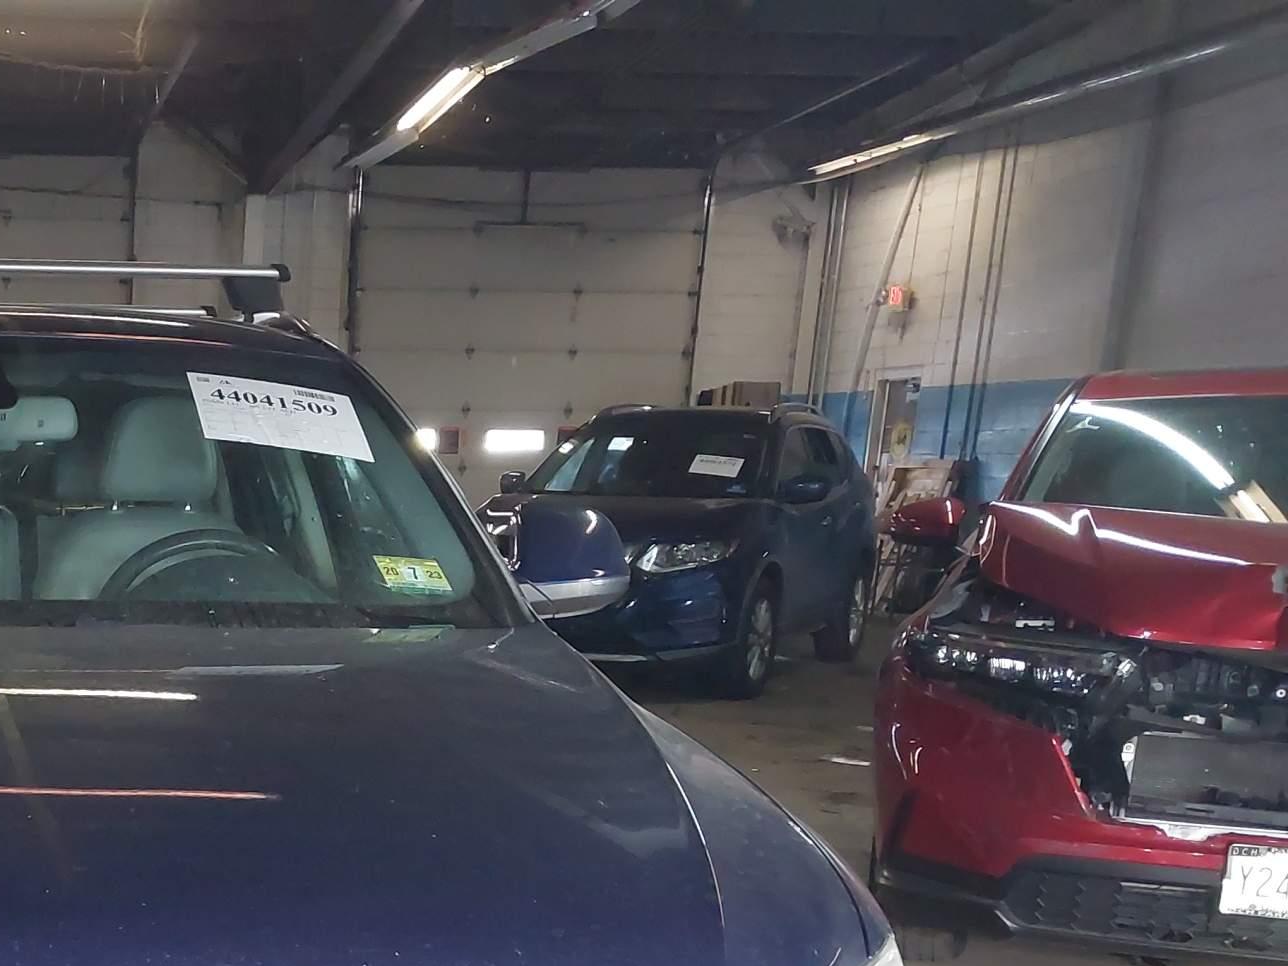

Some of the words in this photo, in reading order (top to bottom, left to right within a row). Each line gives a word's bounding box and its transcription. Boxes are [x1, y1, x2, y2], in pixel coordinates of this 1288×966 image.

[210, 388, 338, 417] 44041509
[383, 566, 399, 576] 20
[407, 566, 418, 580] 7
[1232, 846, 1259, 857] DCH
